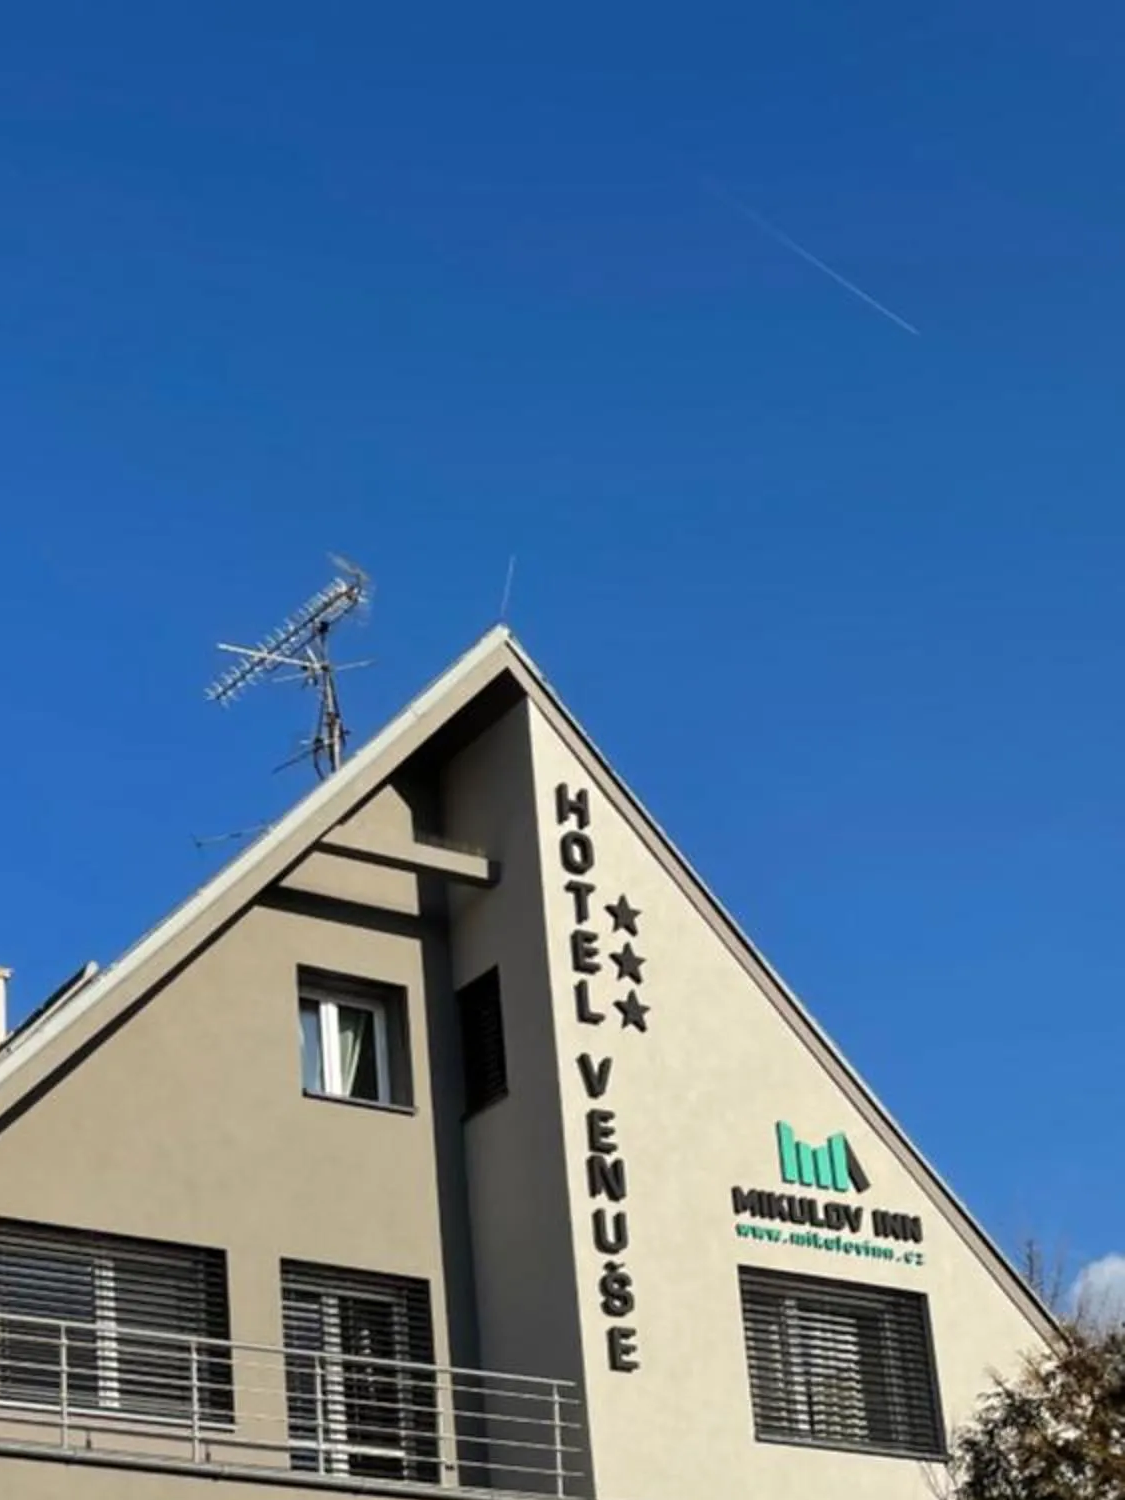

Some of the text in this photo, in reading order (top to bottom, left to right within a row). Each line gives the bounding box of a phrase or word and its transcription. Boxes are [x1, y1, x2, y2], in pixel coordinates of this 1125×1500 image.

[555, 782, 639, 1373] HOTEL VENUŠE
[731, 1186, 923, 1244] MIKULOV INN
